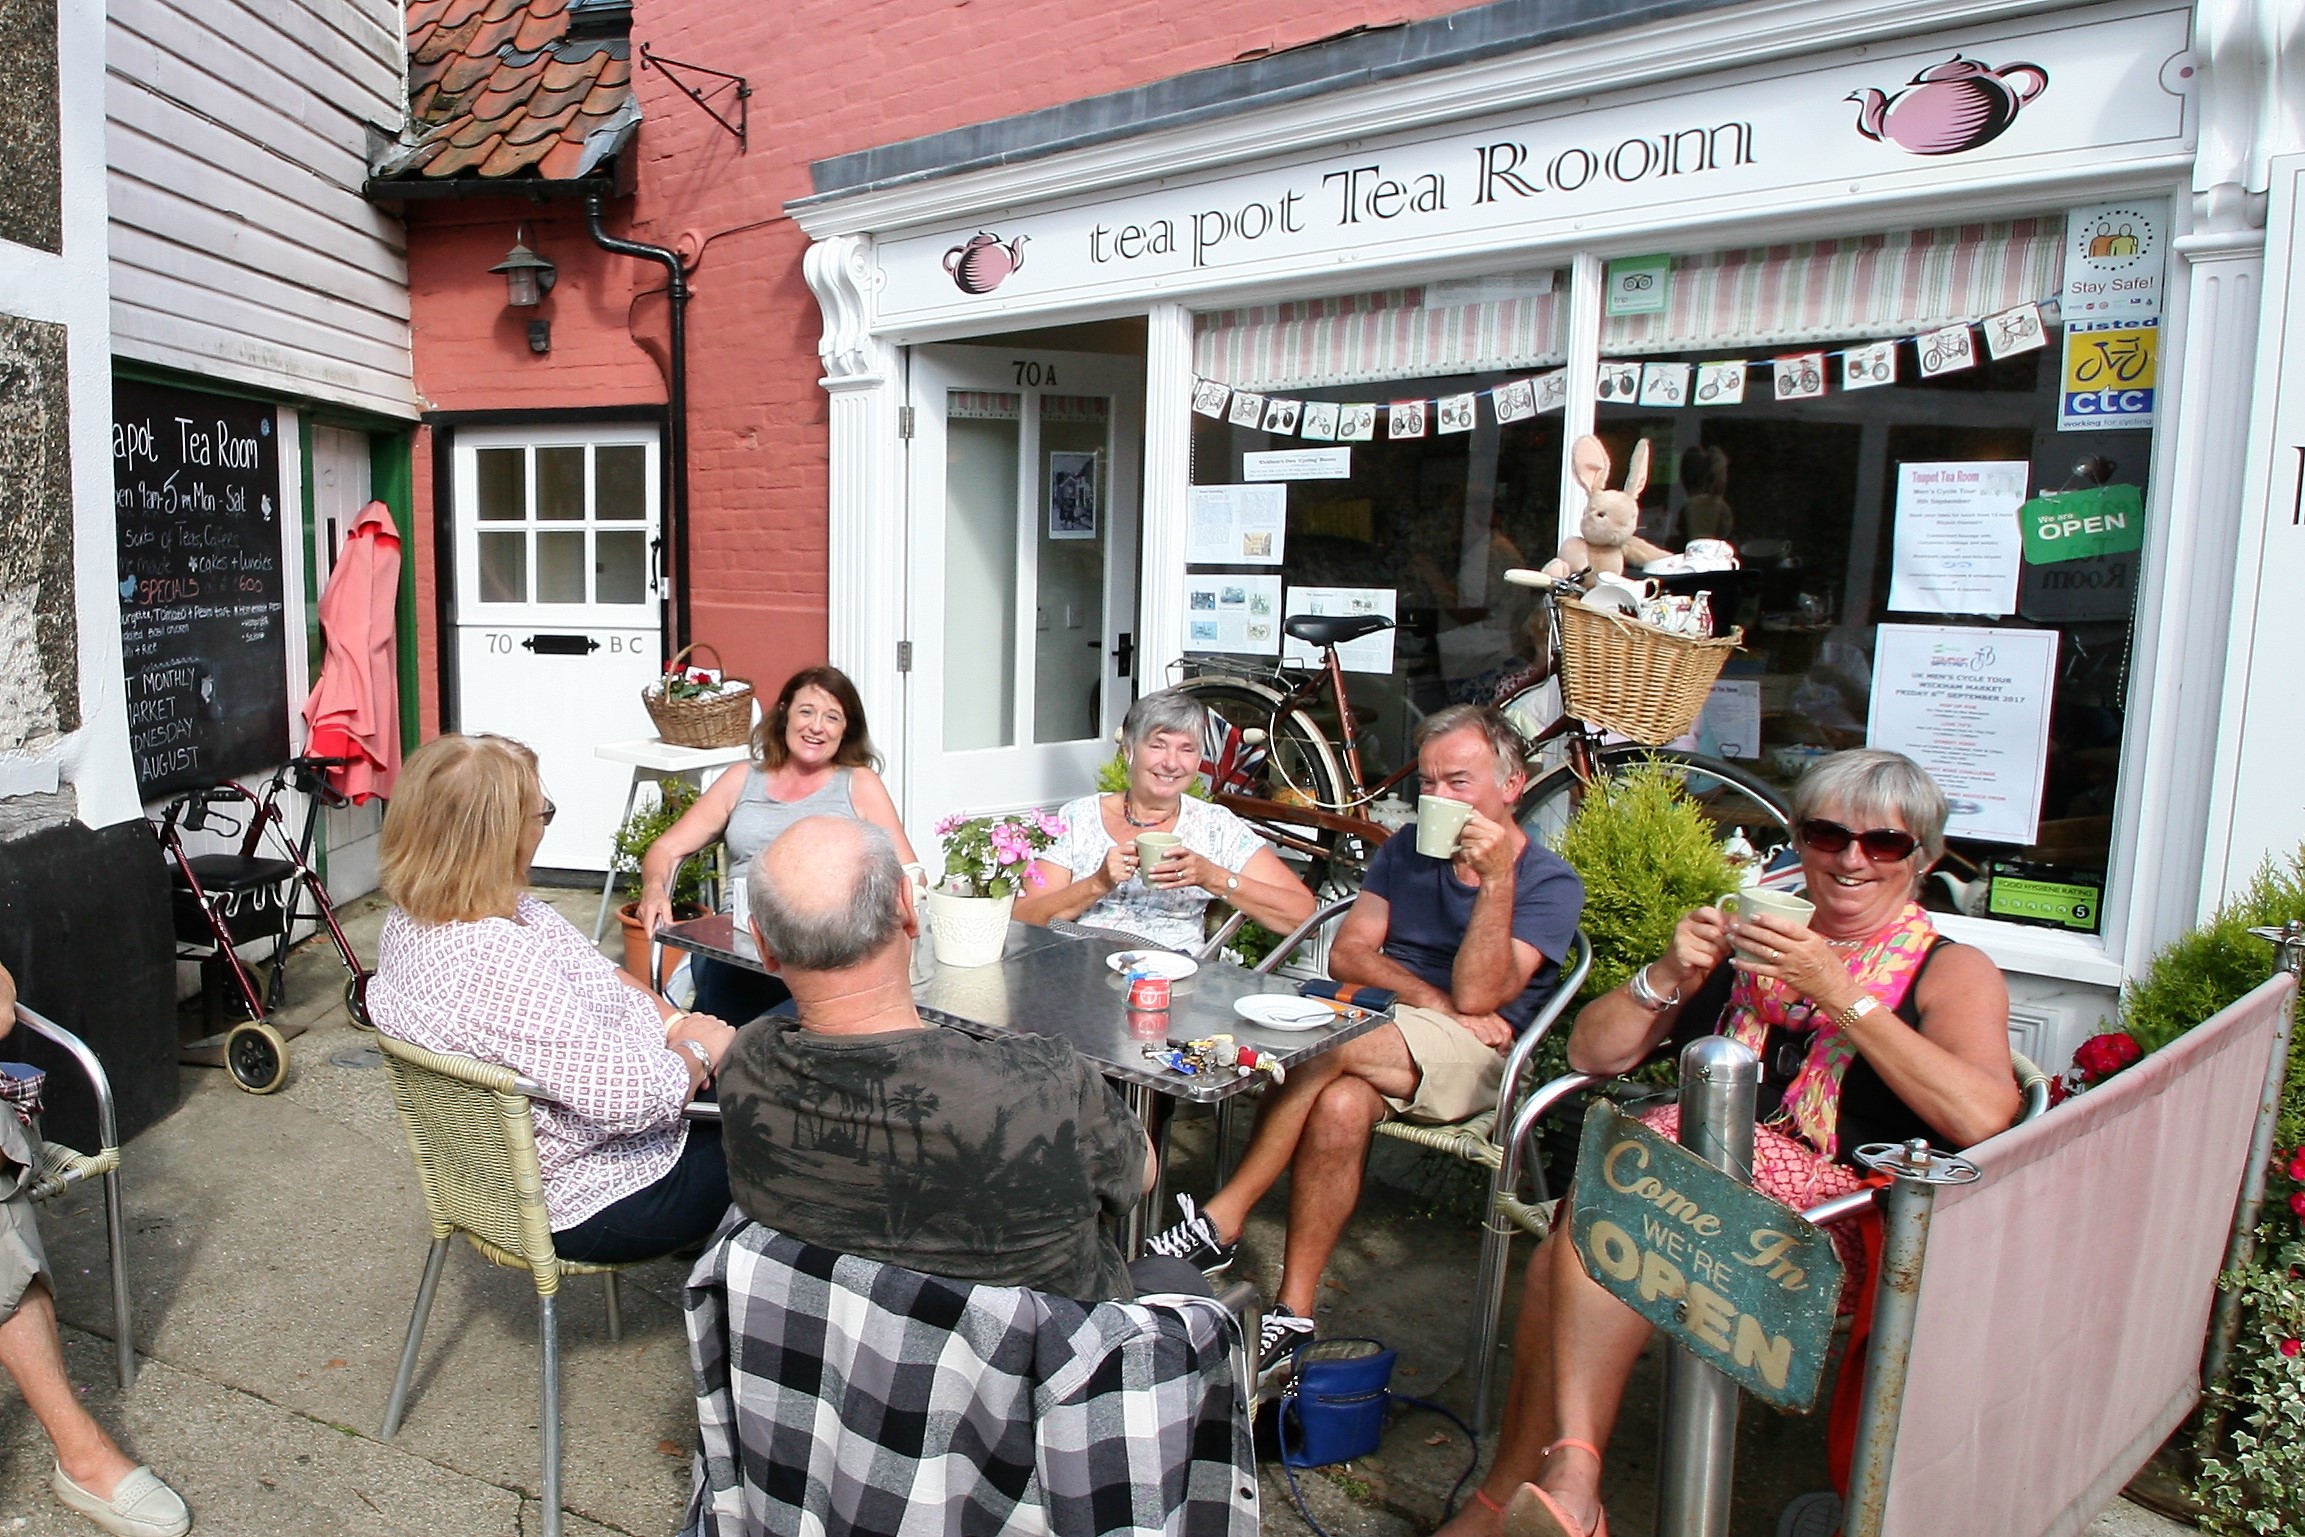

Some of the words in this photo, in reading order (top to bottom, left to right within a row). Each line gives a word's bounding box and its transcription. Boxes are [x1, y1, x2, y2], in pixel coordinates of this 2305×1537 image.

[1321, 164, 1450, 226] Tea
[1471, 121, 1758, 205] Room
[2071, 282, 2106, 295] Stay
[2112, 276, 2153, 291] Safe!
[2069, 317, 2158, 332] Listed
[2072, 384, 2144, 414] ctc
[2063, 419, 2100, 428] working
[2118, 418, 2152, 427] cycling
[175, 416, 210, 465] Tea
[217, 420, 258, 469] Room
[1941, 470, 1955, 483] Tea
[1957, 470, 1980, 483] Room
[226, 484, 246, 512] Sat
[2038, 514, 2055, 524] We
[2057, 513, 2074, 521] are
[2038, 512, 2125, 540] OPEN
[139, 578, 200, 605] SPECIALS
[485, 633, 513, 654] 70
[143, 667, 195, 695] MONTHLY
[1965, 684, 2003, 692] MARKET
[1947, 693, 2000, 701] SEPTEMBER
[141, 746, 198, 782] AUGUST
[2062, 886, 2093, 896] RATING
[2075, 906, 2085, 917] 5
[1604, 1140, 1722, 1237] Come
[1731, 1229, 1810, 1291] In
[1643, 1214, 1735, 1295] WE'RE
[1590, 1220, 1795, 1390] OPEN
